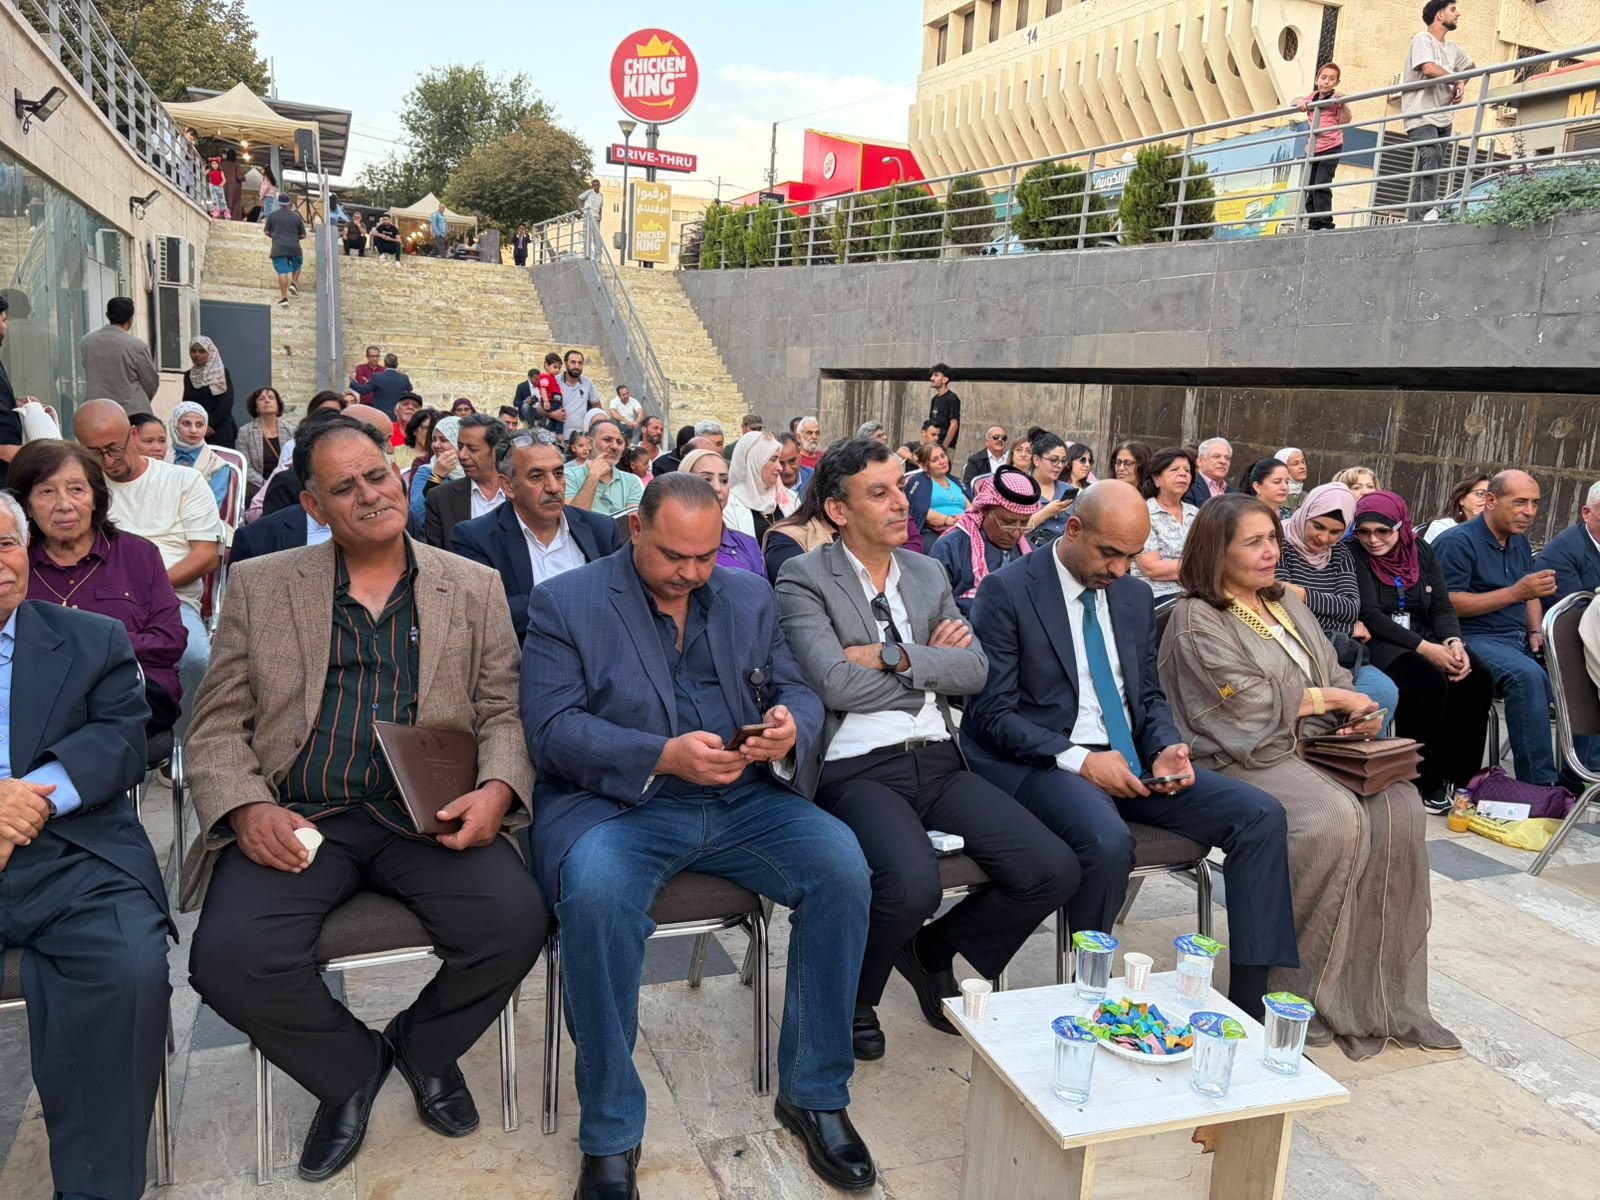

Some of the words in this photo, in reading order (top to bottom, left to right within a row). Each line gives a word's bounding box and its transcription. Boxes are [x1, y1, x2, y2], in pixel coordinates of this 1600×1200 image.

[623, 56, 687, 75] CHICKEN
[623, 73, 676, 98] KING
[616, 147, 693, 168] DRIVE-THRU
[636, 230, 667, 241] CHICKEN
[636, 239, 662, 252] KING
